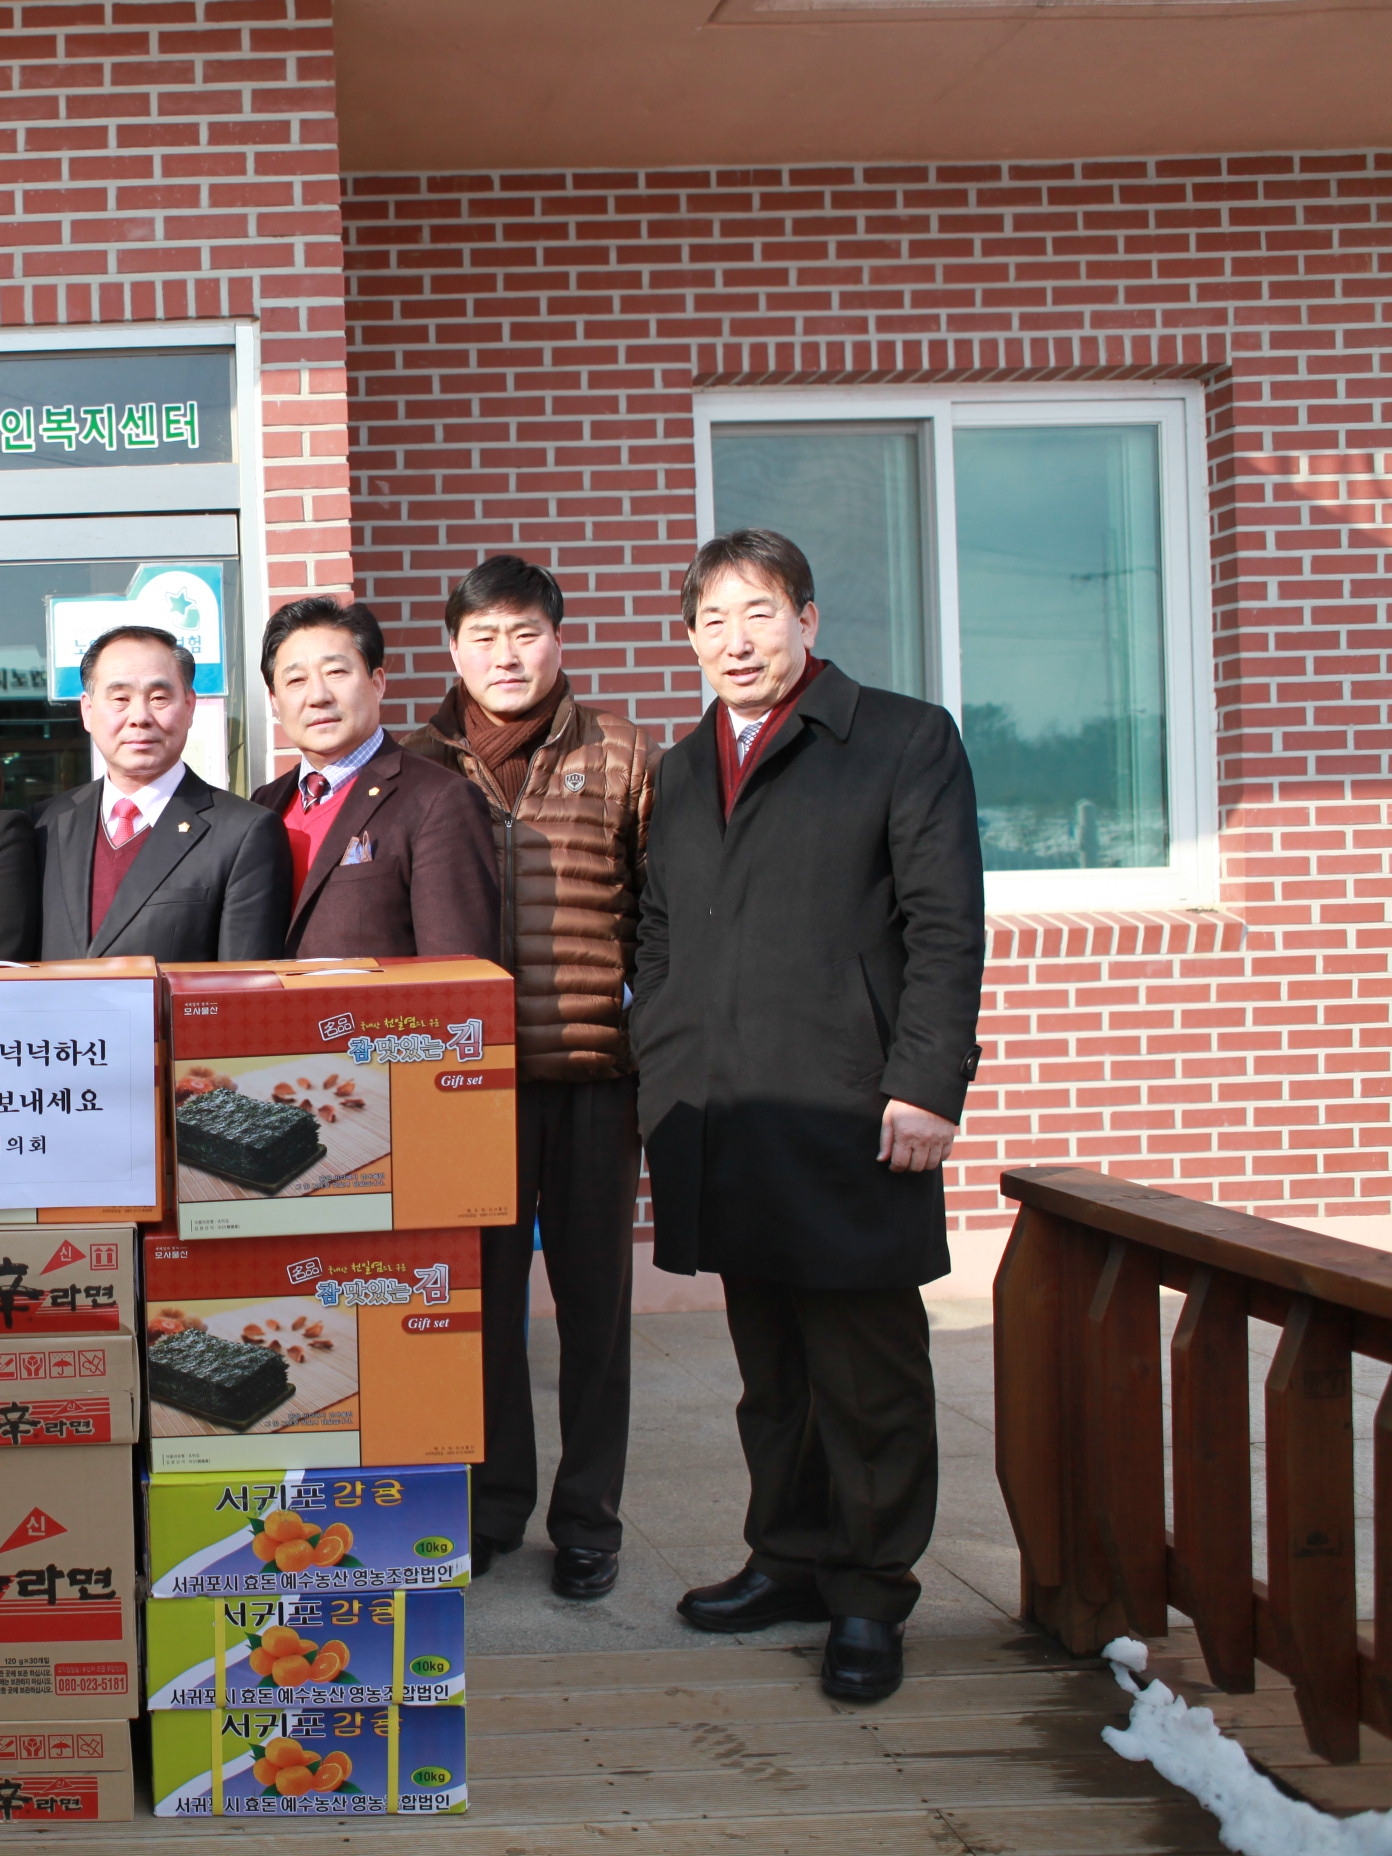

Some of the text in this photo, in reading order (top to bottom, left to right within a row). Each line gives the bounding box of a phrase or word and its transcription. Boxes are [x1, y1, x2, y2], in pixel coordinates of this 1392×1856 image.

[348, 1019, 483, 1064] 참 맛있는 김
[441, 1075, 483, 1088] Gift set
[59, 1247, 72, 1262] 신
[316, 1263, 449, 1307] 참 맛있는 김
[408, 1317, 450, 1330] Gift set
[214, 1479, 405, 1513] 서귀포 감귤
[26, 1515, 46, 1536] 신
[419, 1541, 448, 1555] 10kg
[172, 1564, 453, 1593] 서귀포시 효돈 예수농산 영농조합법인
[224, 1599, 323, 1627] 서귀포
[416, 1660, 444, 1674] 10kg
[58, 1677, 125, 1692] 080-023-5181
[240, 1687, 273, 1706] 효돈
[277, 1685, 344, 1705] 예수농산
[221, 1712, 326, 1739] 서귀포
[417, 1770, 445, 1783] 10kg
[243, 1796, 276, 1813] 효돈
[281, 1795, 347, 1813] 예수농산
